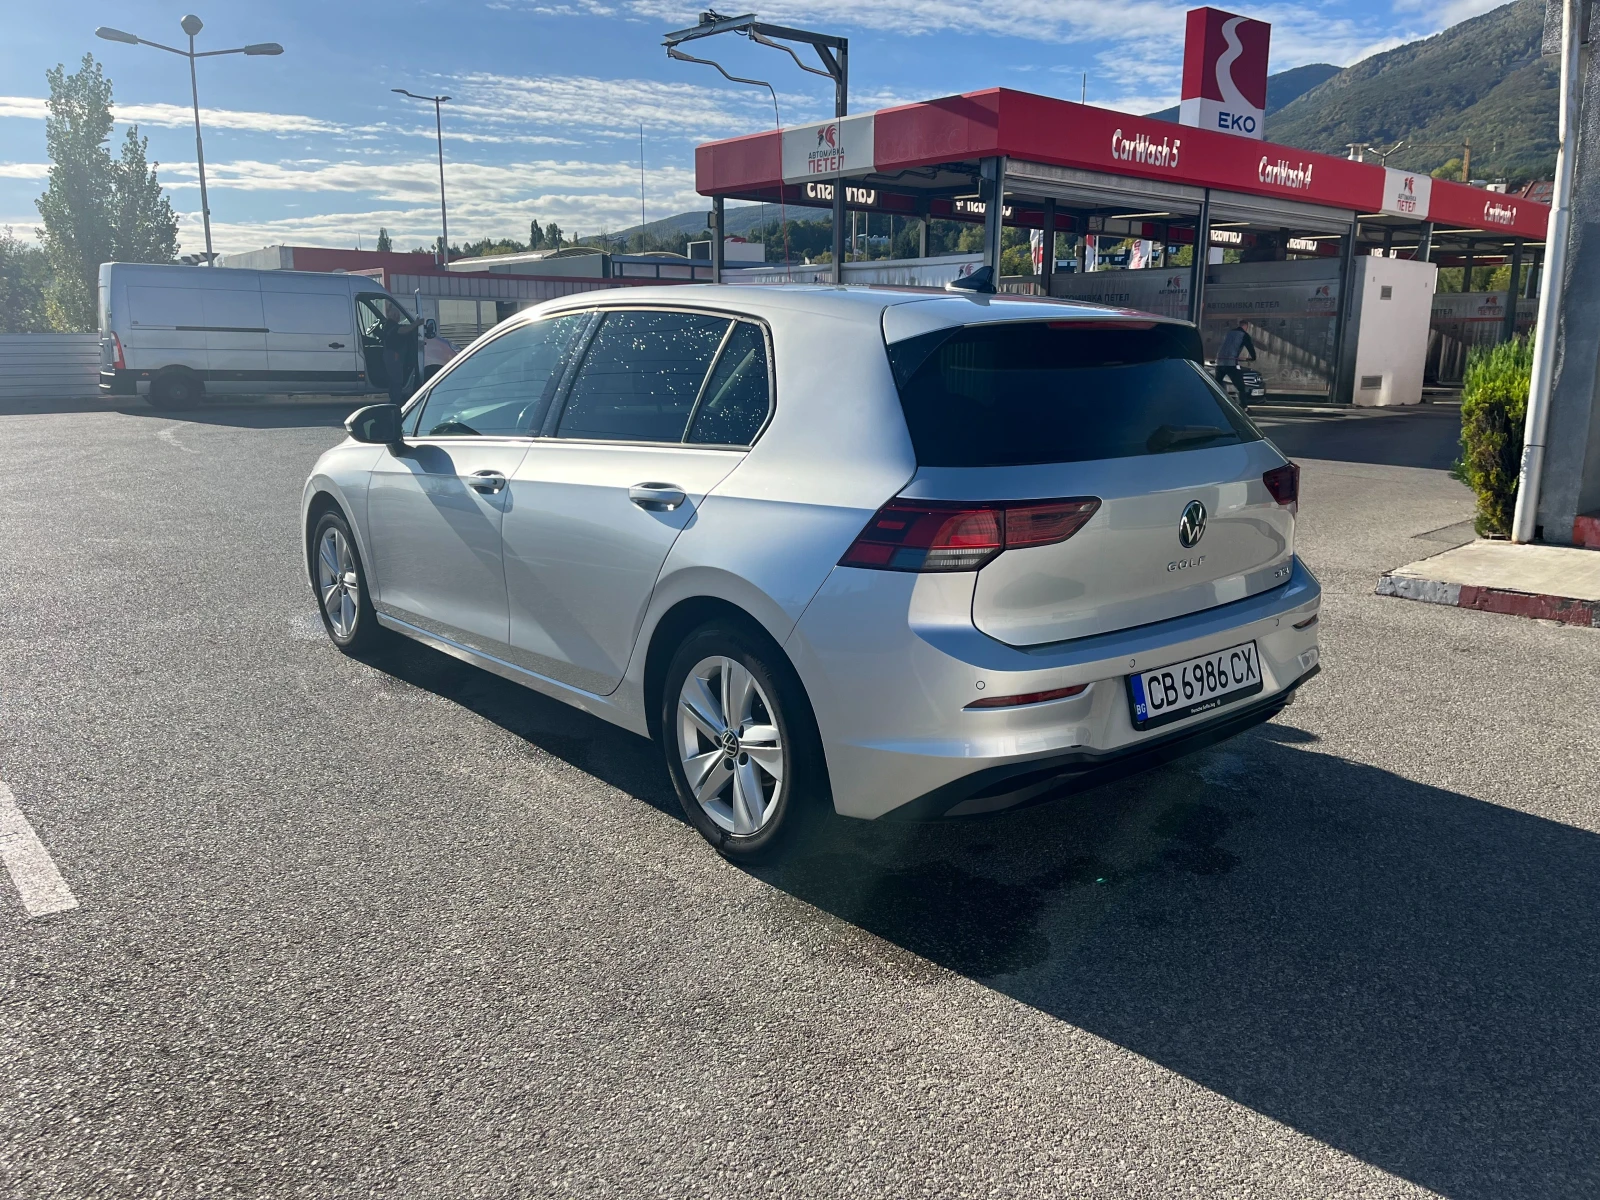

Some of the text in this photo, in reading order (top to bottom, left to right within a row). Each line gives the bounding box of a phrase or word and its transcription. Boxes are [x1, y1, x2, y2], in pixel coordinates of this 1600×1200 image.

[1218, 111, 1256, 133] EKO
[808, 146, 845, 159] АВТОМИВКА
[1112, 128, 1181, 168] CarWash 5
[808, 155, 845, 174] ПЕТЕЛ
[1258, 156, 1313, 190] CarWash 4
[1397, 200, 1417, 213] ПЕТЕЛ
[1104, 293, 1130, 302] ПЕТЕЛ
[1206, 300, 1280, 310] АВТОМИВКА ПЕТЕЛ
[1167, 555, 1206, 573] GOLF
[1136, 703, 1147, 715] BG
